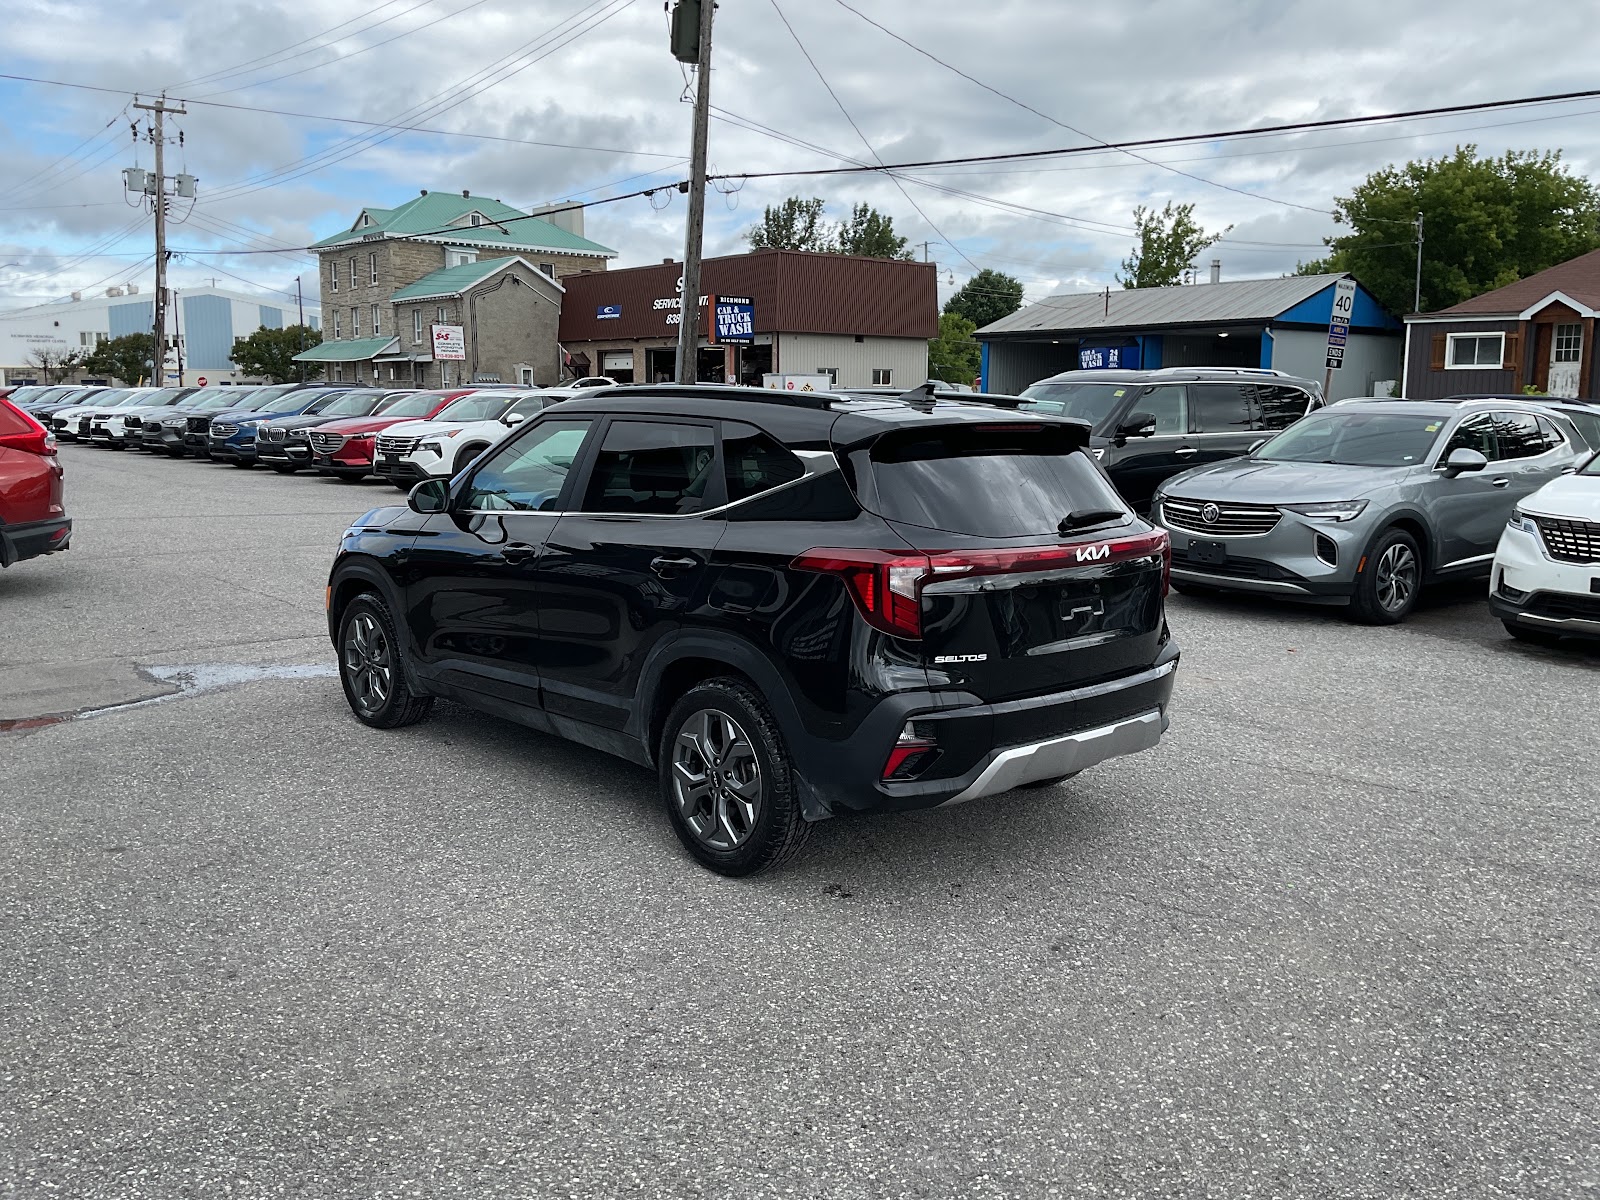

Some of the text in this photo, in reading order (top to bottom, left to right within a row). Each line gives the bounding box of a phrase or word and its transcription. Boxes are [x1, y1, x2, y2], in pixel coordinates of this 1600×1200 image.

[1336, 295, 1351, 312] 40
[717, 306, 732, 314] CAR
[718, 312, 751, 324] TRUCK
[719, 322, 752, 336] WASH
[1329, 348, 1342, 356] ENDS
[1082, 353, 1102, 362] TRUCK
[1082, 359, 1102, 369] WASH
[1076, 544, 1110, 562] KIA
[934, 653, 988, 663] SELTOS
